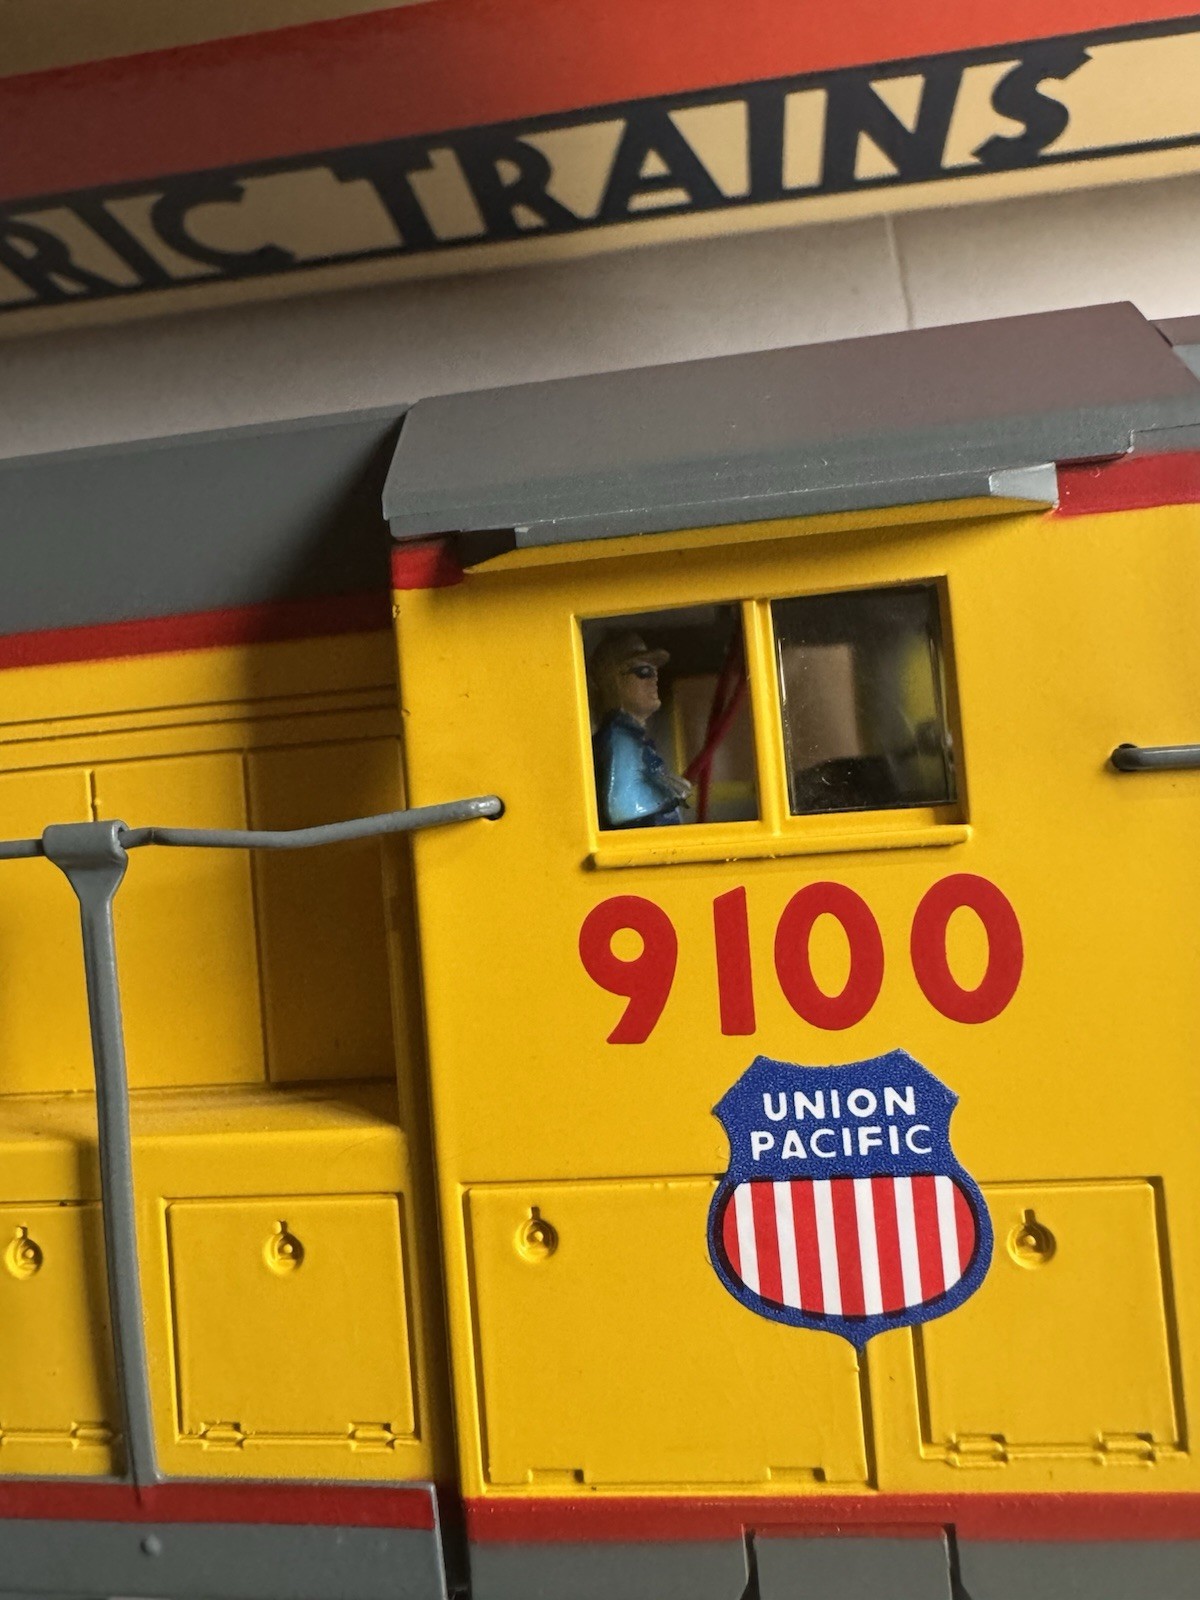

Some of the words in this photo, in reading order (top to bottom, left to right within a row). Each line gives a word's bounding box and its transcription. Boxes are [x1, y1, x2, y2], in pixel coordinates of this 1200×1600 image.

[330, 43, 1094, 250] TRAINS
[578, 873, 1025, 1044] 9100
[750, 1123, 933, 1161] PACIFIC
[762, 1085, 917, 1122] UNION
